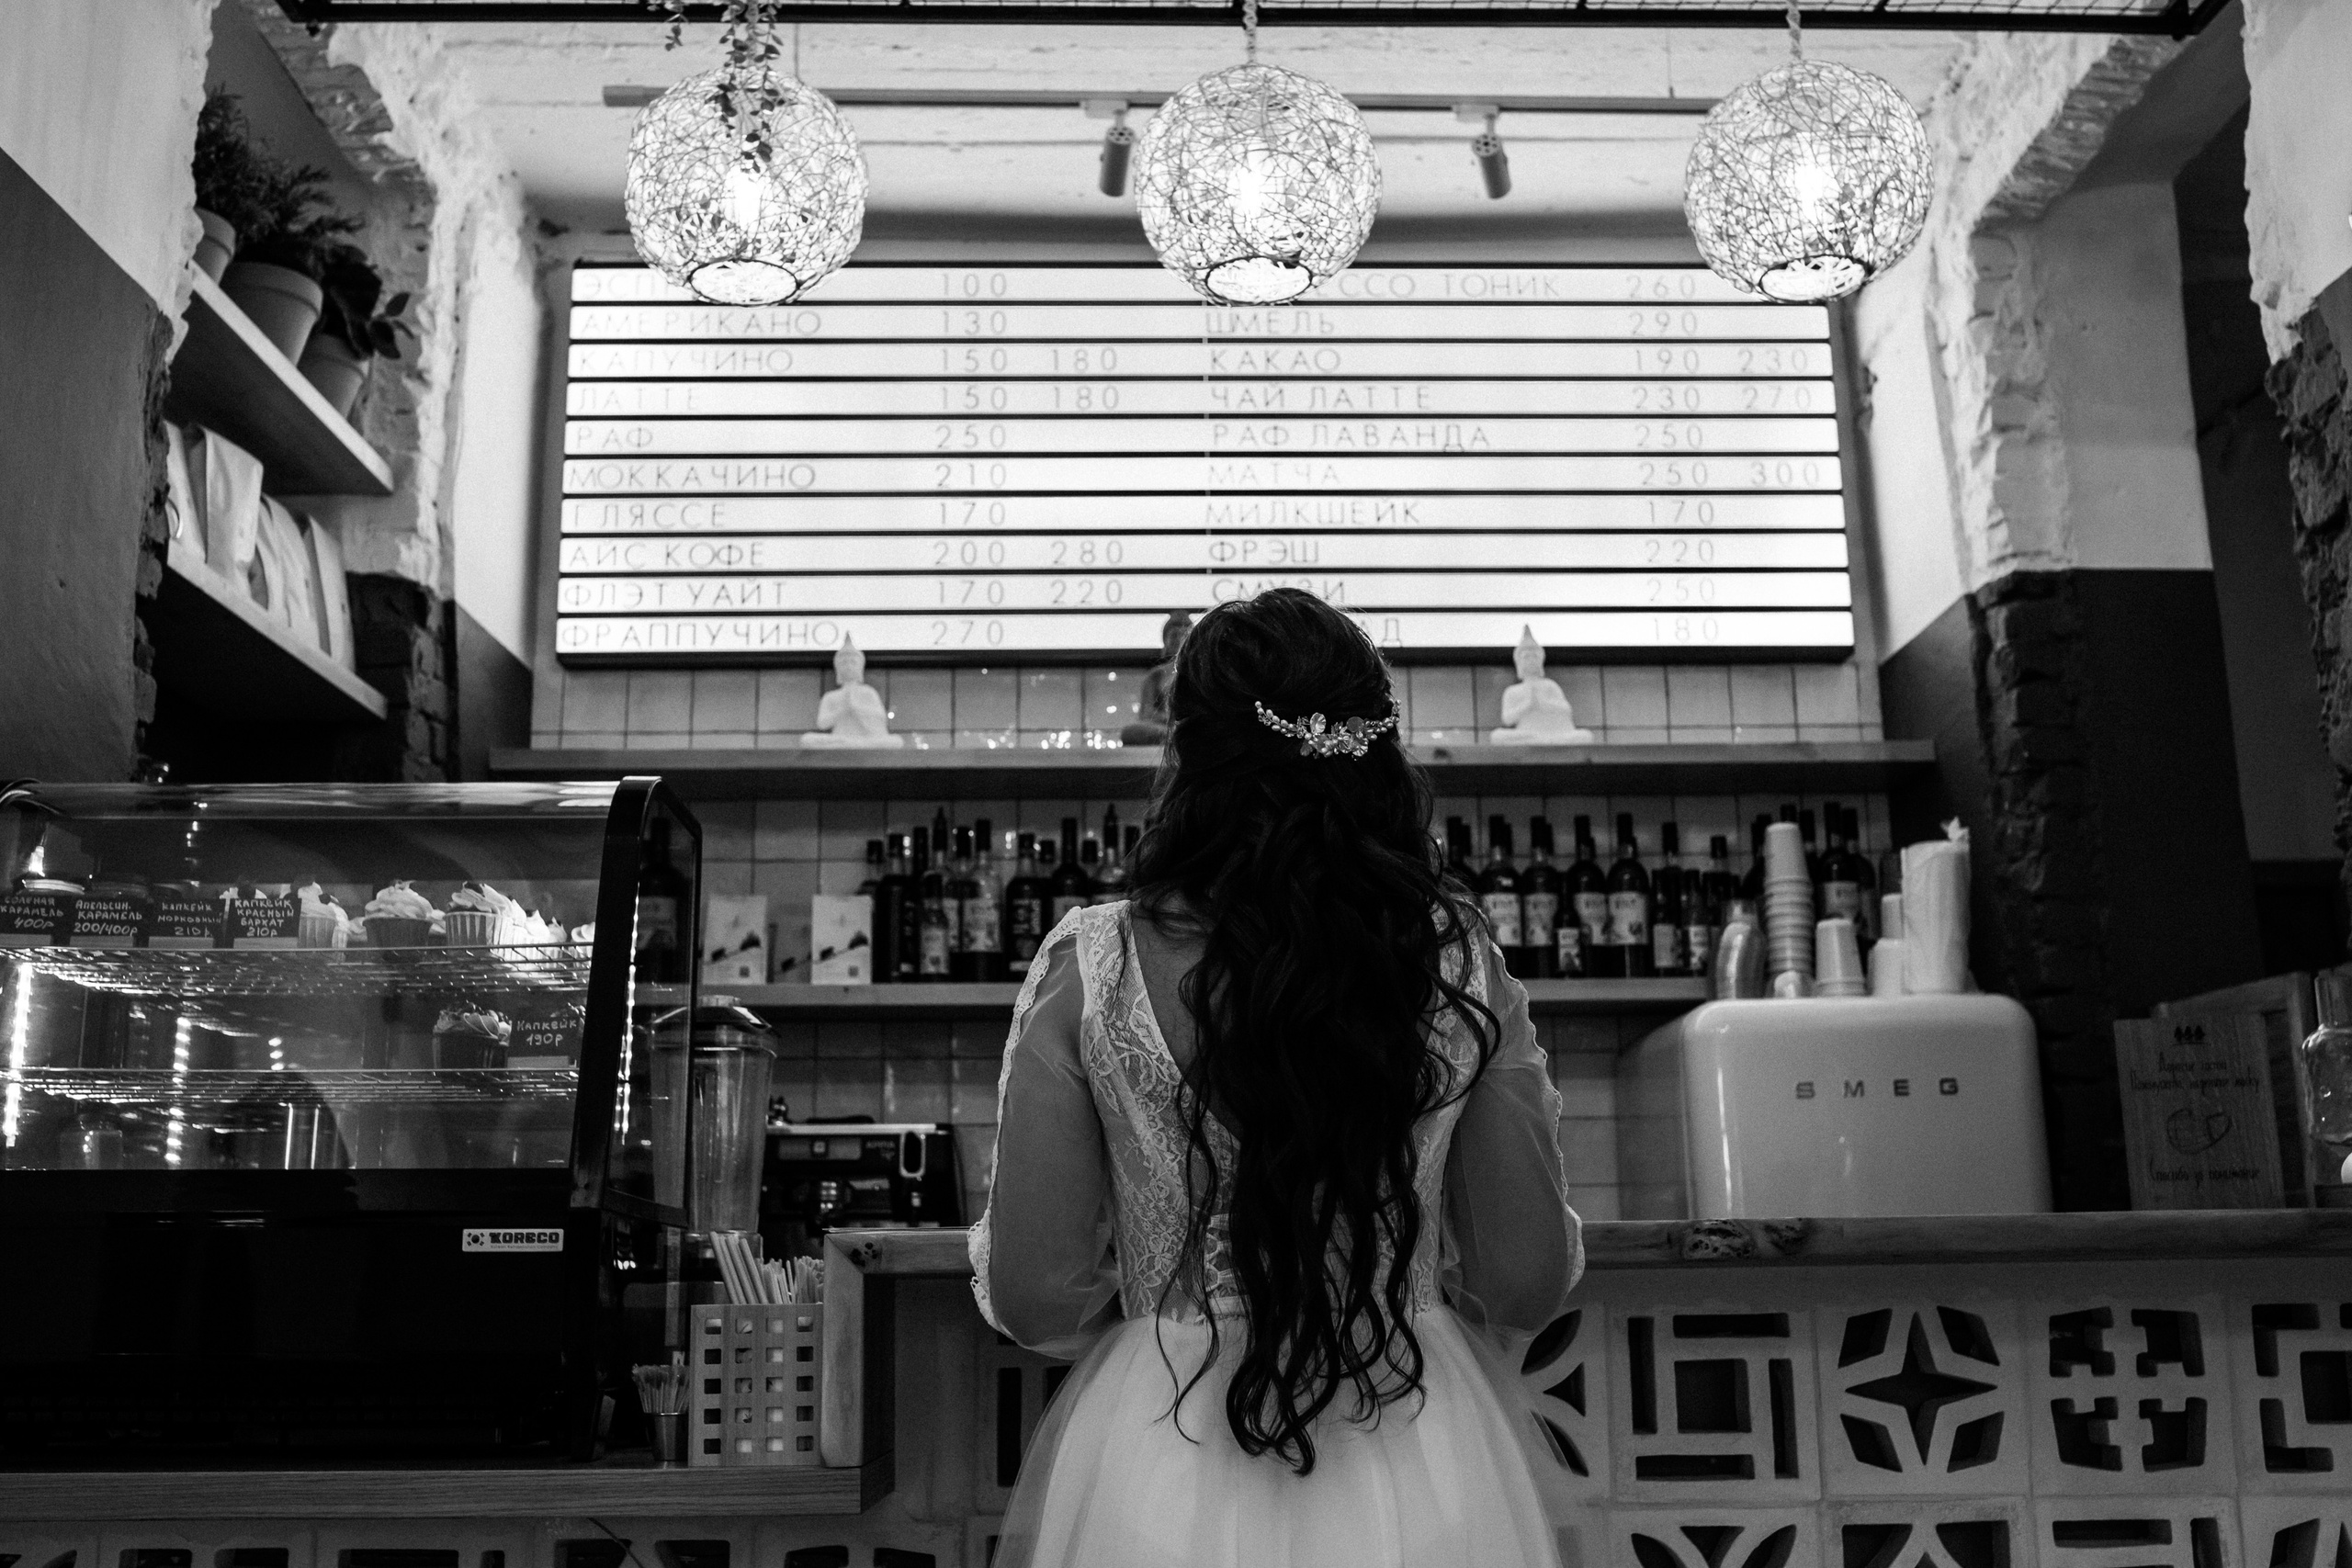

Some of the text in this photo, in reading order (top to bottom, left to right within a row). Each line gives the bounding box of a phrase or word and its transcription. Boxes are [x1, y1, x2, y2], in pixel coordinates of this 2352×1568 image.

[943, 273, 1008, 298] 100
[1443, 274, 1561, 299] ТОНИК
[1625, 274, 1696, 299] 260
[582, 310, 1008, 336] АМЕРИКАНО 130
[1204, 310, 1698, 336] ШМЕЛЬ 290
[580, 346, 1117, 374] КАПУЧИНО 150 180
[1209, 347, 1808, 374] КАКАО 190 230
[576, 385, 1120, 412] ЛАТТЕ 150 180
[1211, 382, 1812, 412] ЧАЙ ЛАТТЕ 230 270
[576, 423, 1007, 450] РАФ 250
[1213, 423, 1703, 451] РАФ ЛАВАНДА 250
[569, 462, 1007, 489] МОККАЧИНО 210
[1207, 460, 1820, 487] МАТЧА 250 300
[573, 501, 1006, 529] ГЛЯССЕ 170
[1204, 497, 1714, 525] МИЛКШЕЙК 170
[568, 539, 1124, 570] АЙС КОФЕ 200 280
[1208, 537, 1714, 566] ФРЭШ 220
[564, 578, 1123, 609] ФЛЭТ УАЙТ 170 220
[1646, 576, 1715, 603] 250
[561, 619, 1004, 649] ФРАППУЧИНО 270
[1653, 615, 1720, 643] 180
[1795, 1077, 1959, 1100] SMEG
